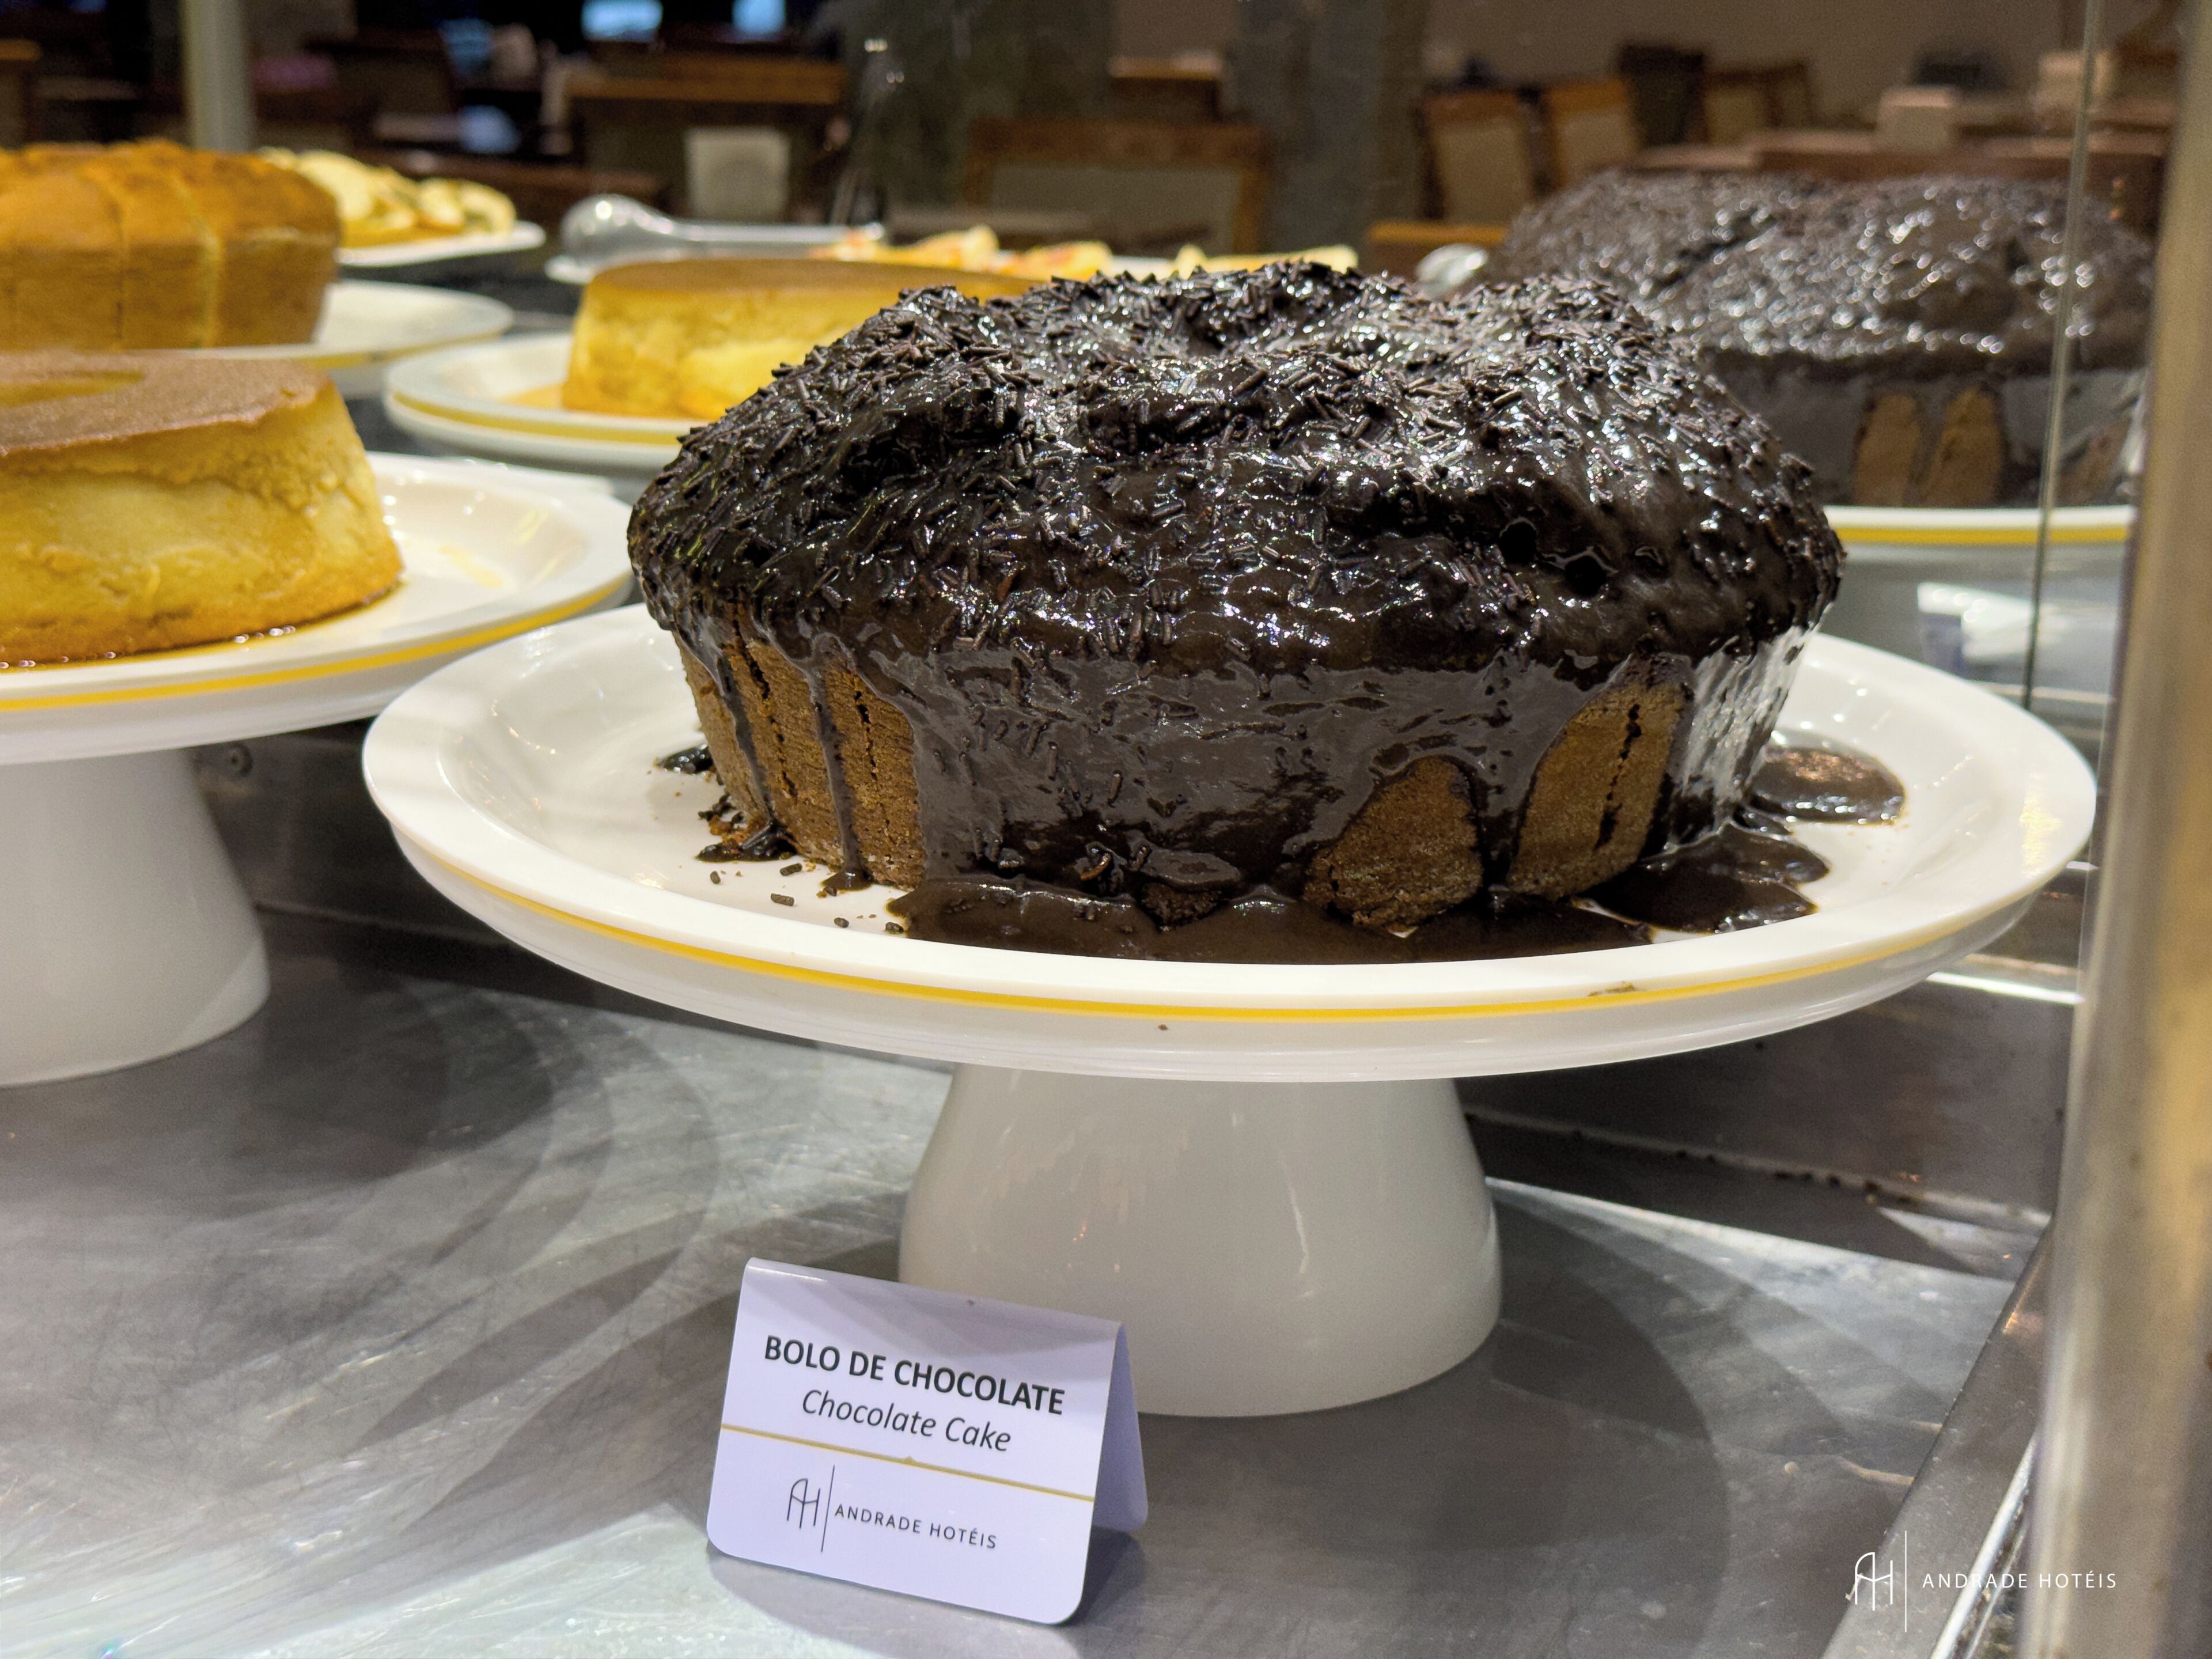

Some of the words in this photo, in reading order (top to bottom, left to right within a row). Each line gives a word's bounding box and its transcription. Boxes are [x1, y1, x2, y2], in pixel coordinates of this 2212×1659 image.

[764, 1335, 840, 1372] BOLO
[849, 1350, 887, 1381] DE
[894, 1359, 1065, 1415] CHOCOLATE
[802, 1389, 937, 1437] Chocolate
[945, 1417, 1012, 1452] Cake
[834, 1503, 922, 1534] ANDRADE
[929, 1524, 997, 1549] HOTÉIS
